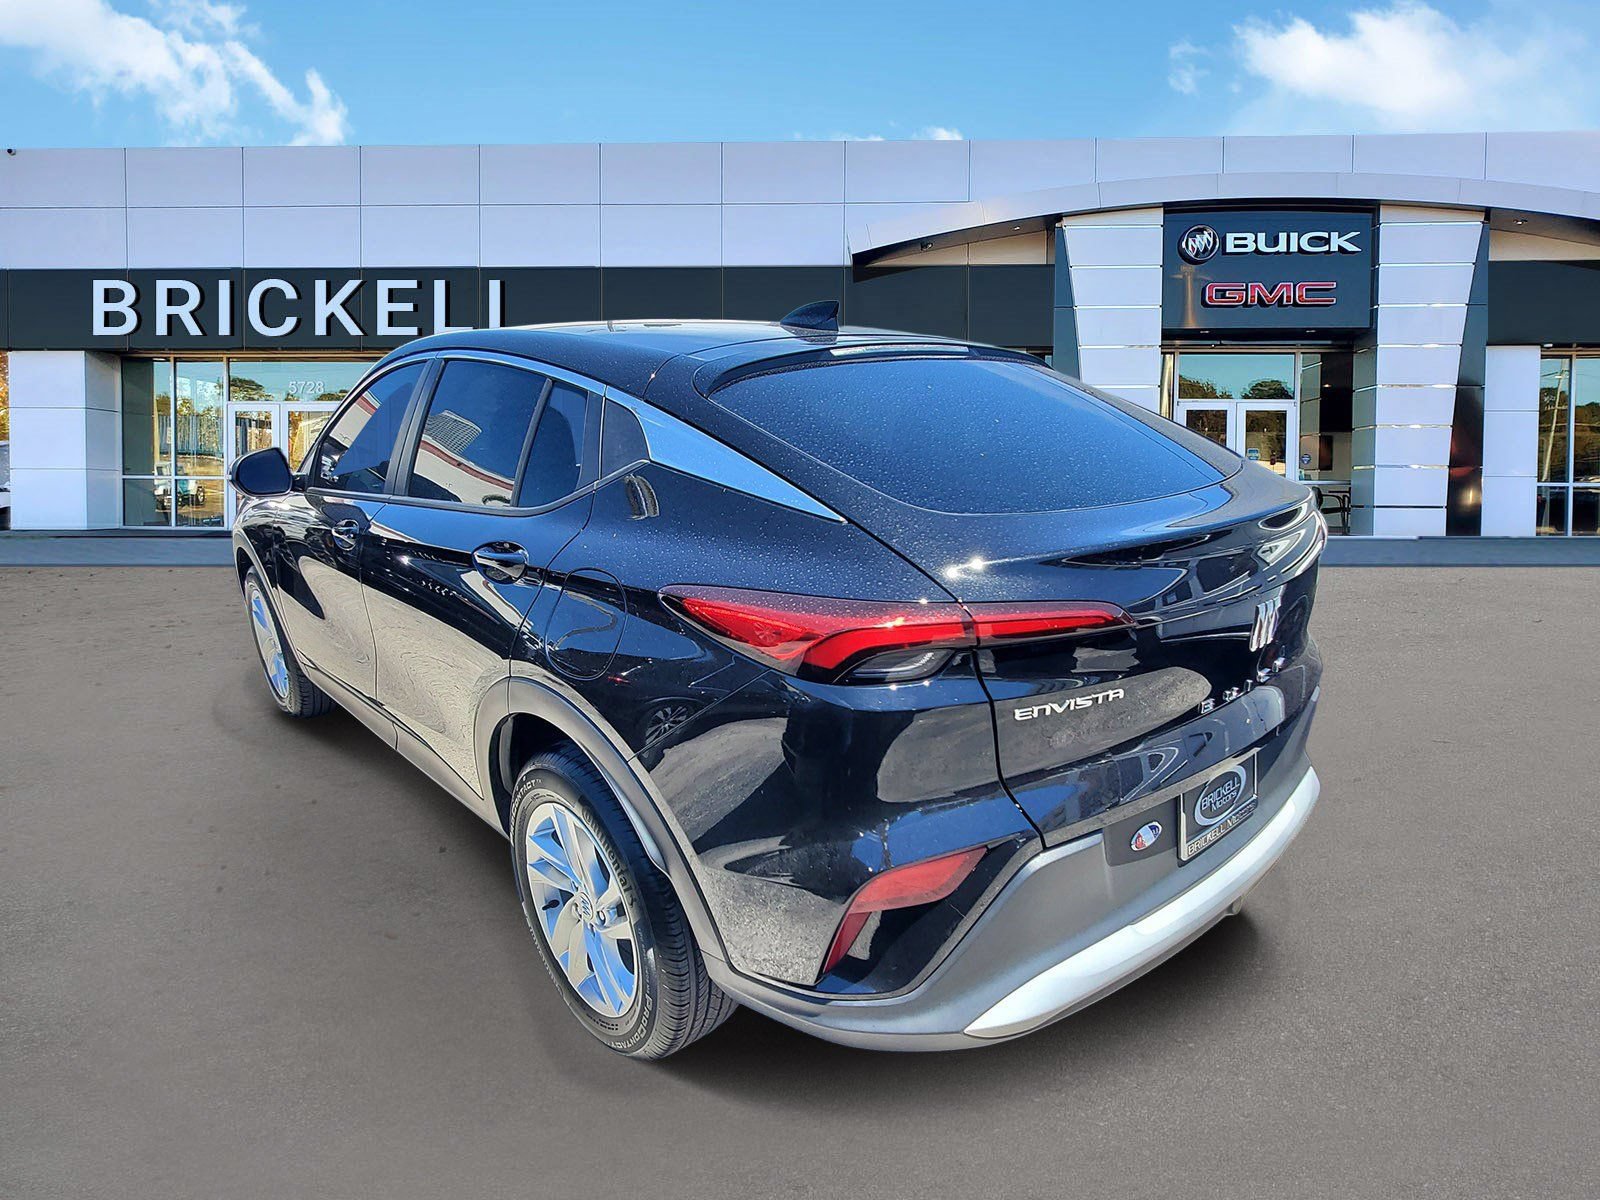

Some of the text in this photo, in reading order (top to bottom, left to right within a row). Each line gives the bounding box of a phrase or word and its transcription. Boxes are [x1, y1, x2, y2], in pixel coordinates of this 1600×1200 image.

[1226, 231, 1362, 253] BUICK
[91, 278, 502, 337] BRICKELL
[1206, 281, 1337, 305] GMC
[288, 380, 325, 394] 5728
[1013, 687, 1125, 721] ENVISTA
[1201, 777, 1240, 811] BRICKELL
